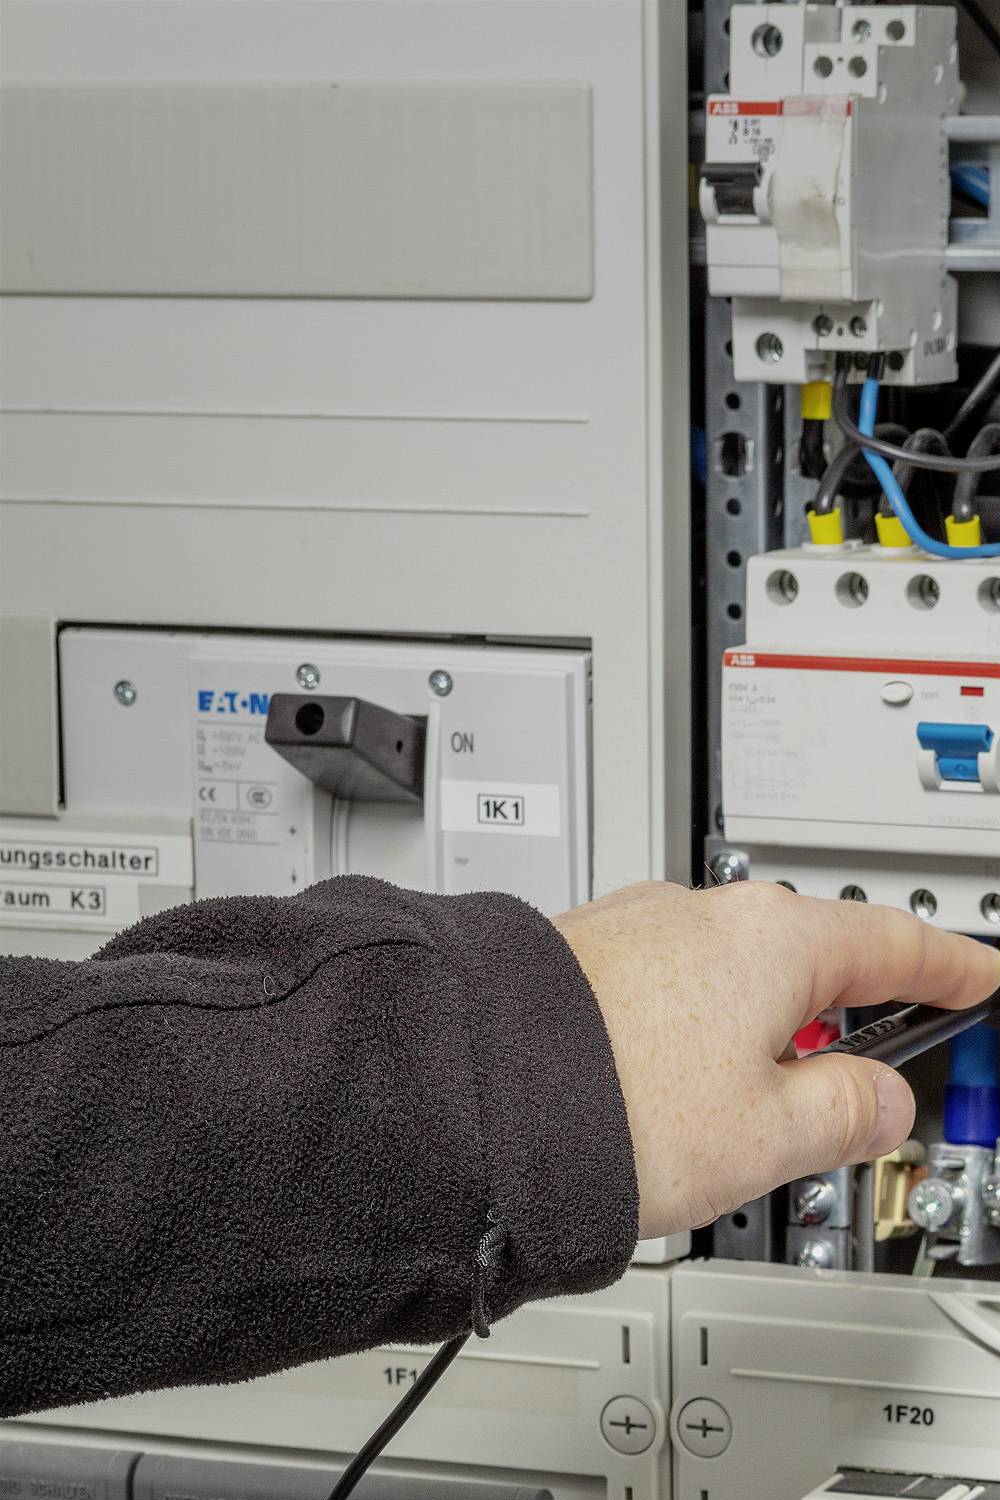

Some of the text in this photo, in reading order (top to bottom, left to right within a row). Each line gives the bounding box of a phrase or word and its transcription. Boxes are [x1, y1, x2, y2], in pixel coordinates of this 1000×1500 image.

[730, 654, 756, 666] ABB
[451, 732, 474, 754] ON
[483, 799, 520, 821] 1K1
[0, 848, 153, 871] ungsschalter
[0, 890, 50, 907] aum
[883, 1404, 935, 1427] 1F20
